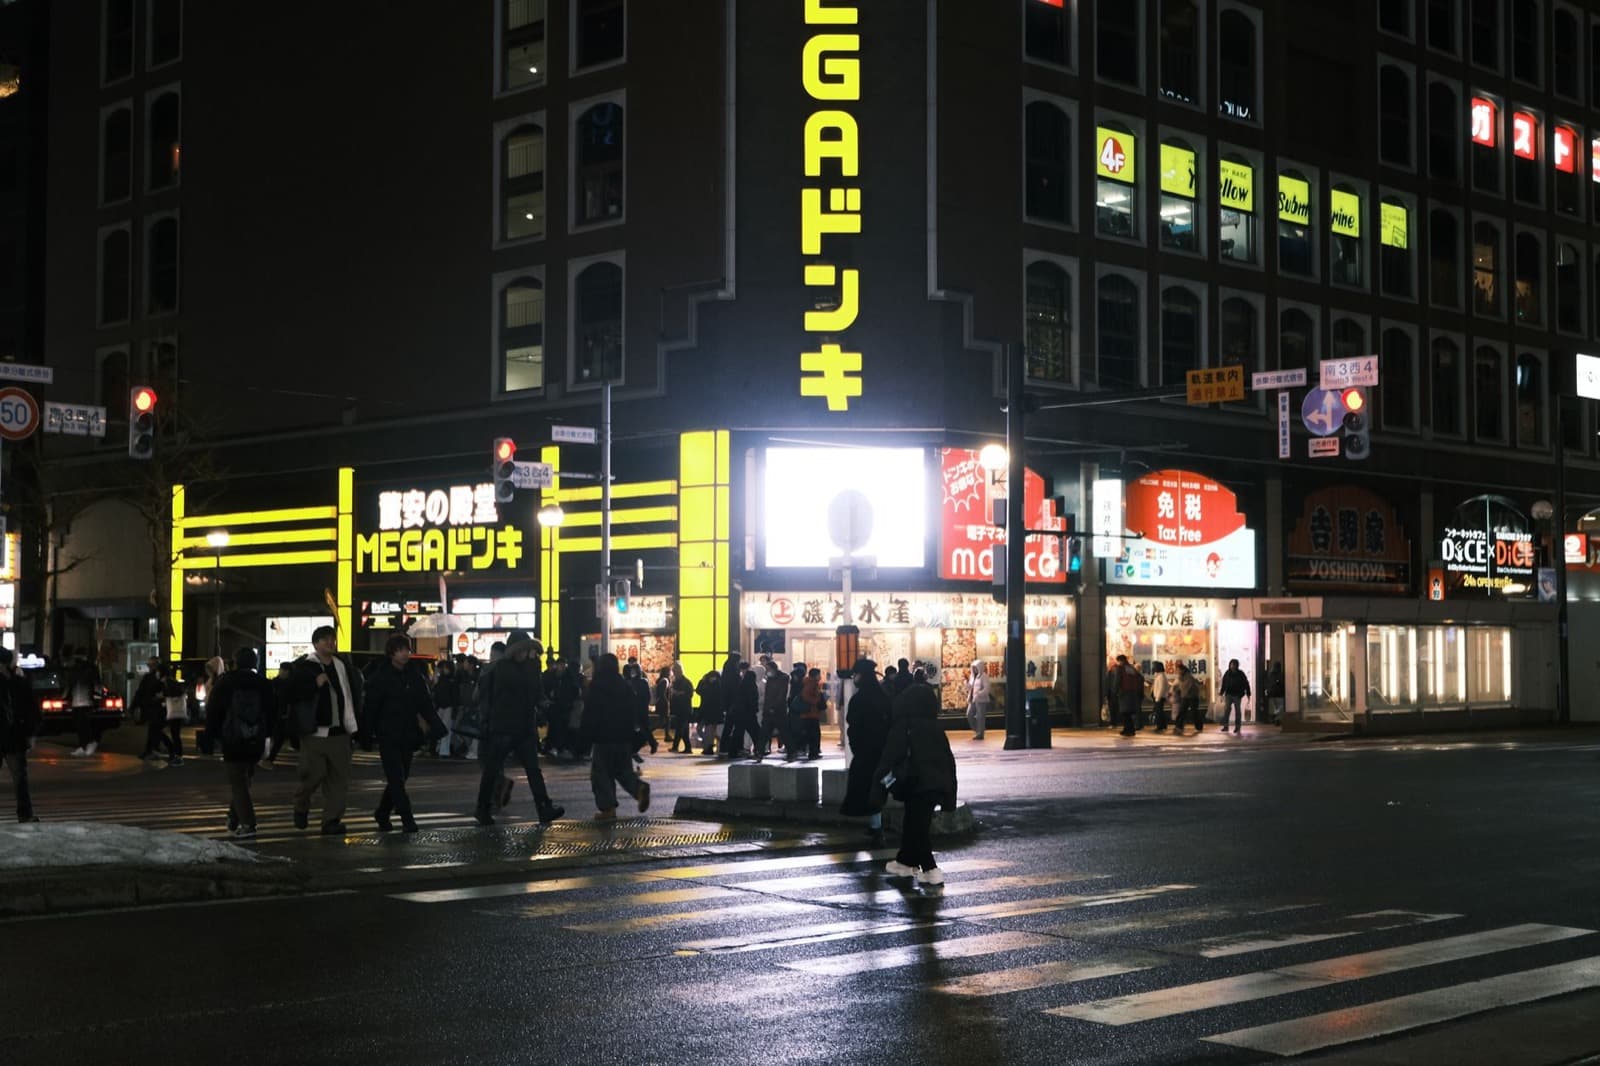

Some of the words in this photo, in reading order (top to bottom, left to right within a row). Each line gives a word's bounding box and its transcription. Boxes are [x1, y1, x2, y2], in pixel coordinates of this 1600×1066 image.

[1101, 138, 1125, 172] 4F
[1325, 360, 1373, 377] 南3西4
[1191, 385, 1238, 401] 通行禁止
[1, 402, 28, 425] 50
[1157, 491, 1202, 521] 免税
[1157, 525, 1177, 541] Tax
[1179, 526, 1202, 542] Free
[356, 524, 523, 574] MEGAドンキ
[951, 547, 1059, 578] maca
